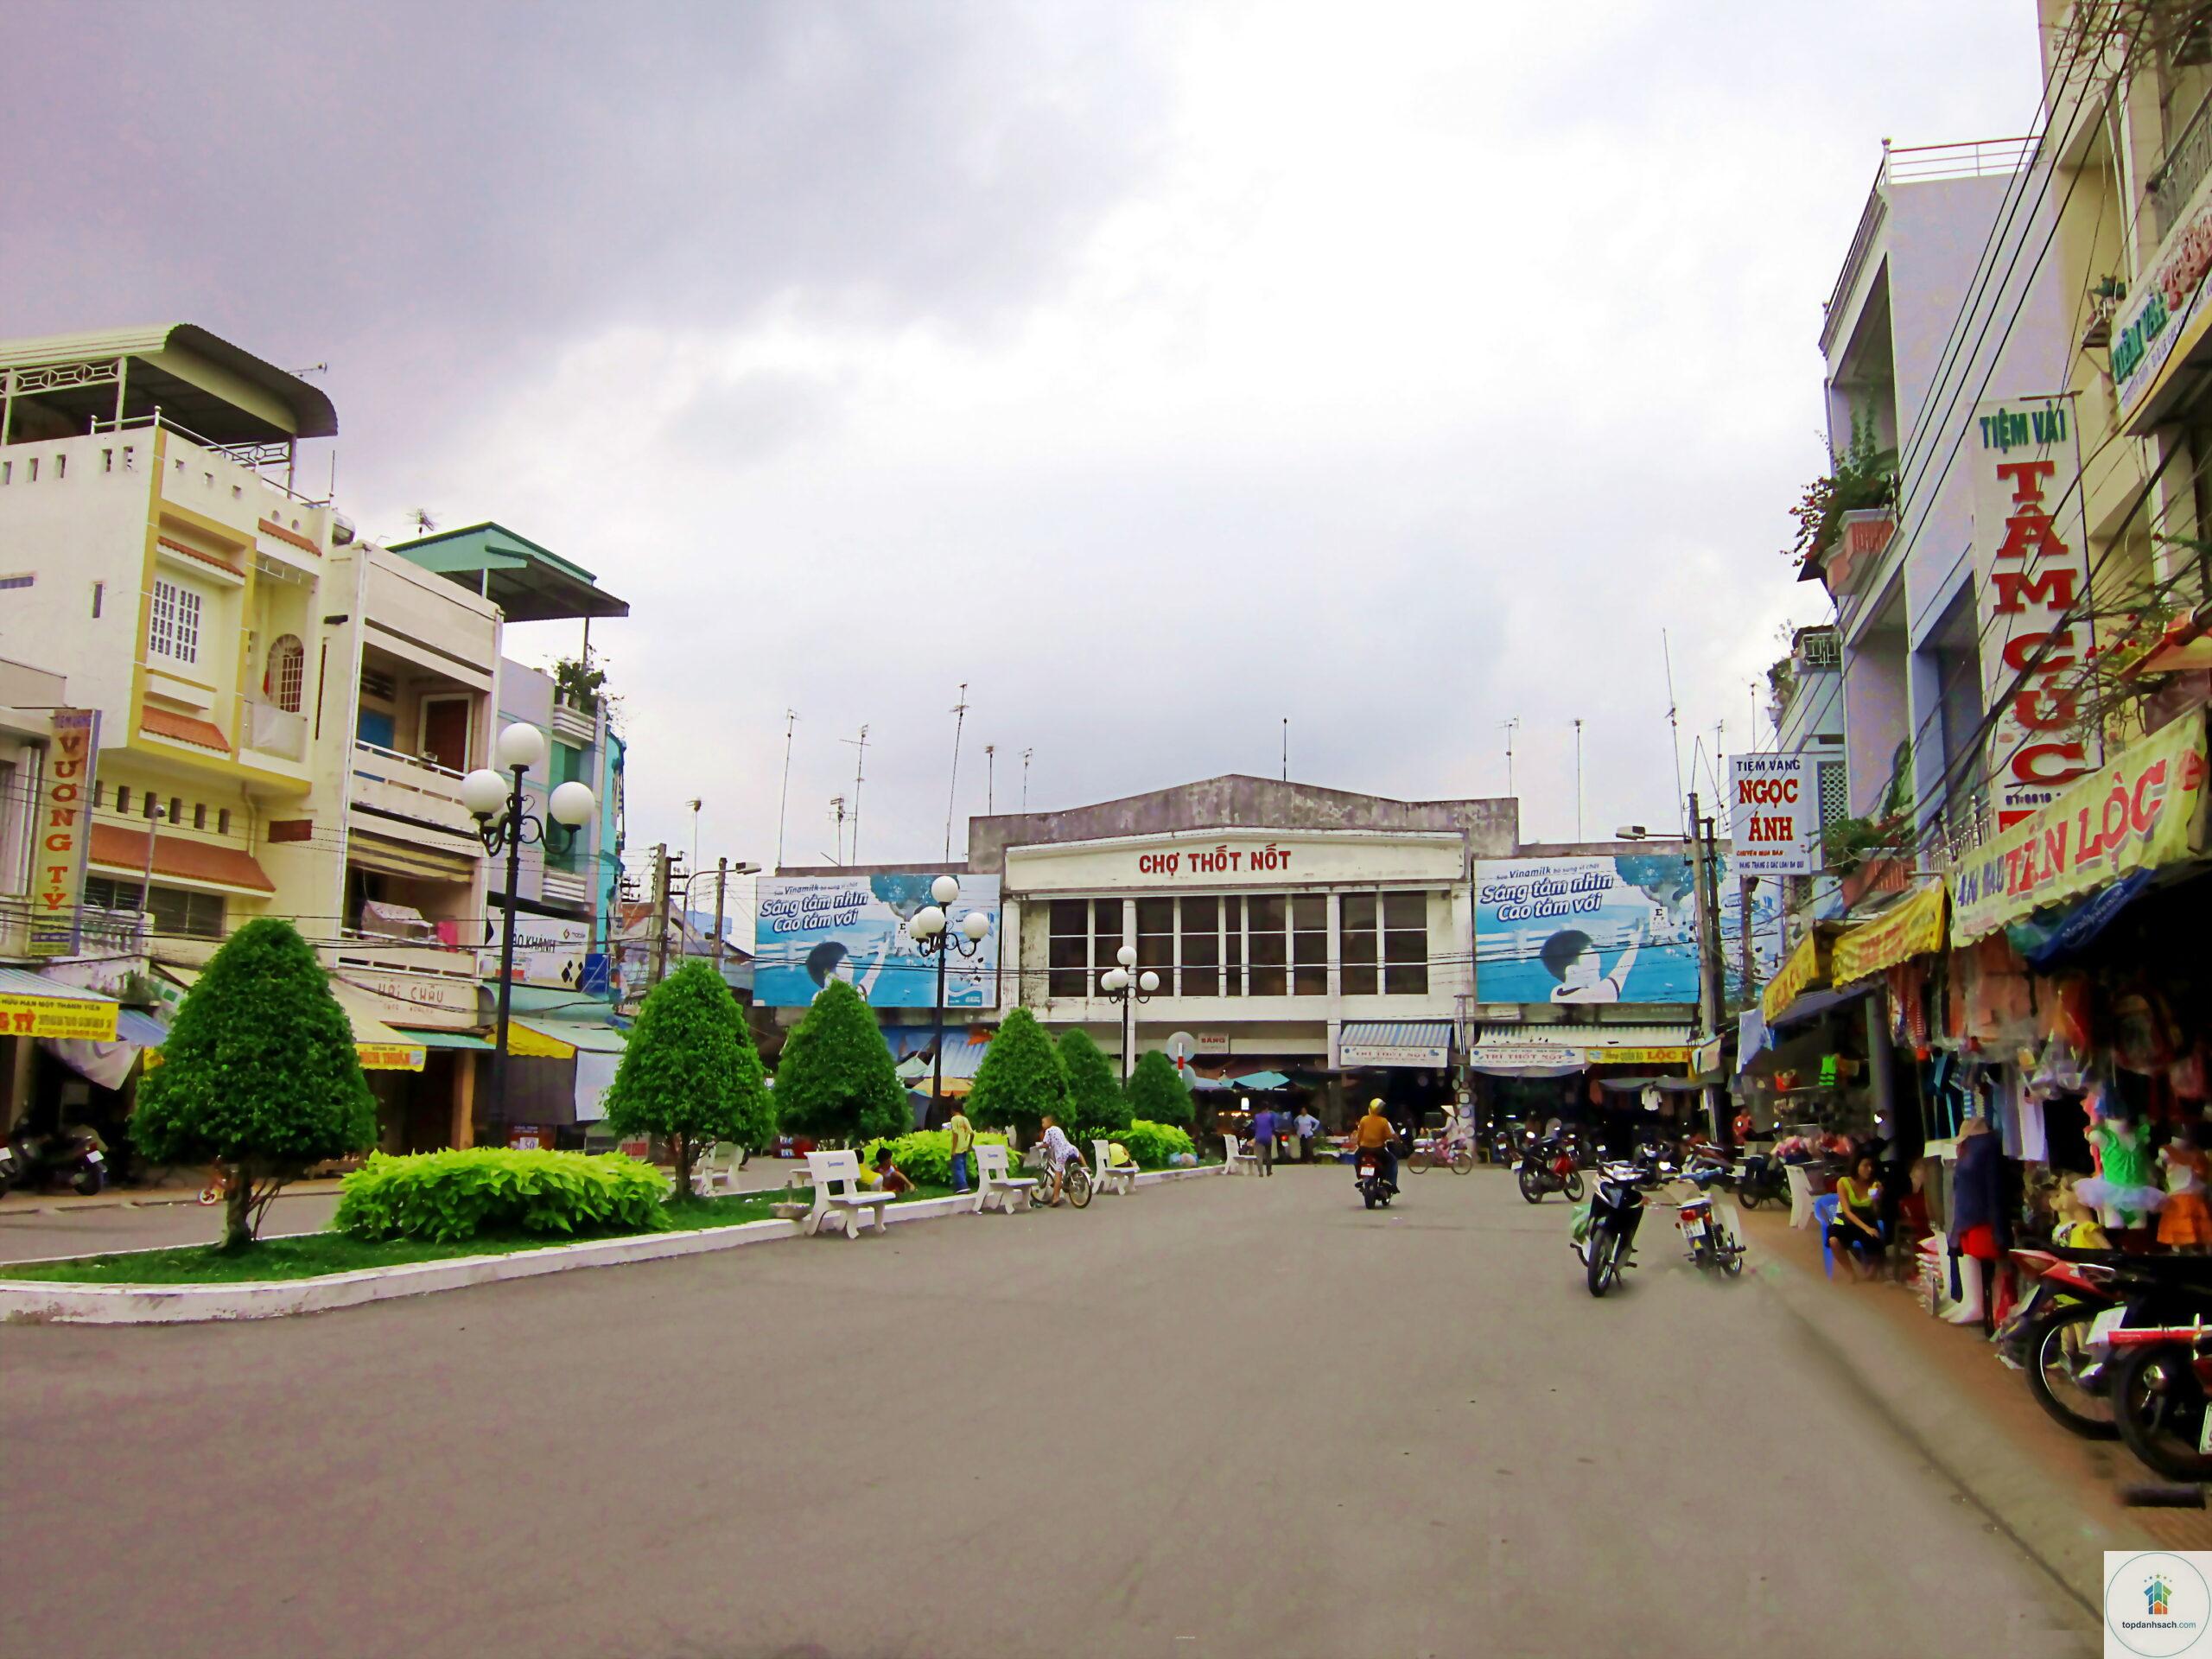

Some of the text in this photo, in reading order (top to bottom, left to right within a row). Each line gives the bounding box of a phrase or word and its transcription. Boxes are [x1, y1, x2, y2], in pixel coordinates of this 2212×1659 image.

[1980, 408, 2028, 454] TIỆM
[1992, 461, 2087, 786] TÂM CÚC
[46, 736, 82, 852] VƯƠNG
[1738, 779, 1798, 809] NGỌC
[2075, 759, 2167, 865] LỘC
[1749, 810, 1793, 841] ÁNH
[1140, 843, 1292, 876] CHỢ THỐT NỐT
[1510, 867, 1551, 879] Vinamilk
[42, 866, 68, 911] TỶ
[785, 884, 819, 895] Vinamilk
[1480, 884, 1529, 904] Sáng
[760, 899, 799, 918] Sáng
[1497, 904, 1532, 922] Cao
[773, 917, 801, 933] Cao
[410, 986, 444, 1003] CHÂU
[1647, 1049, 1676, 1061] LỘC
